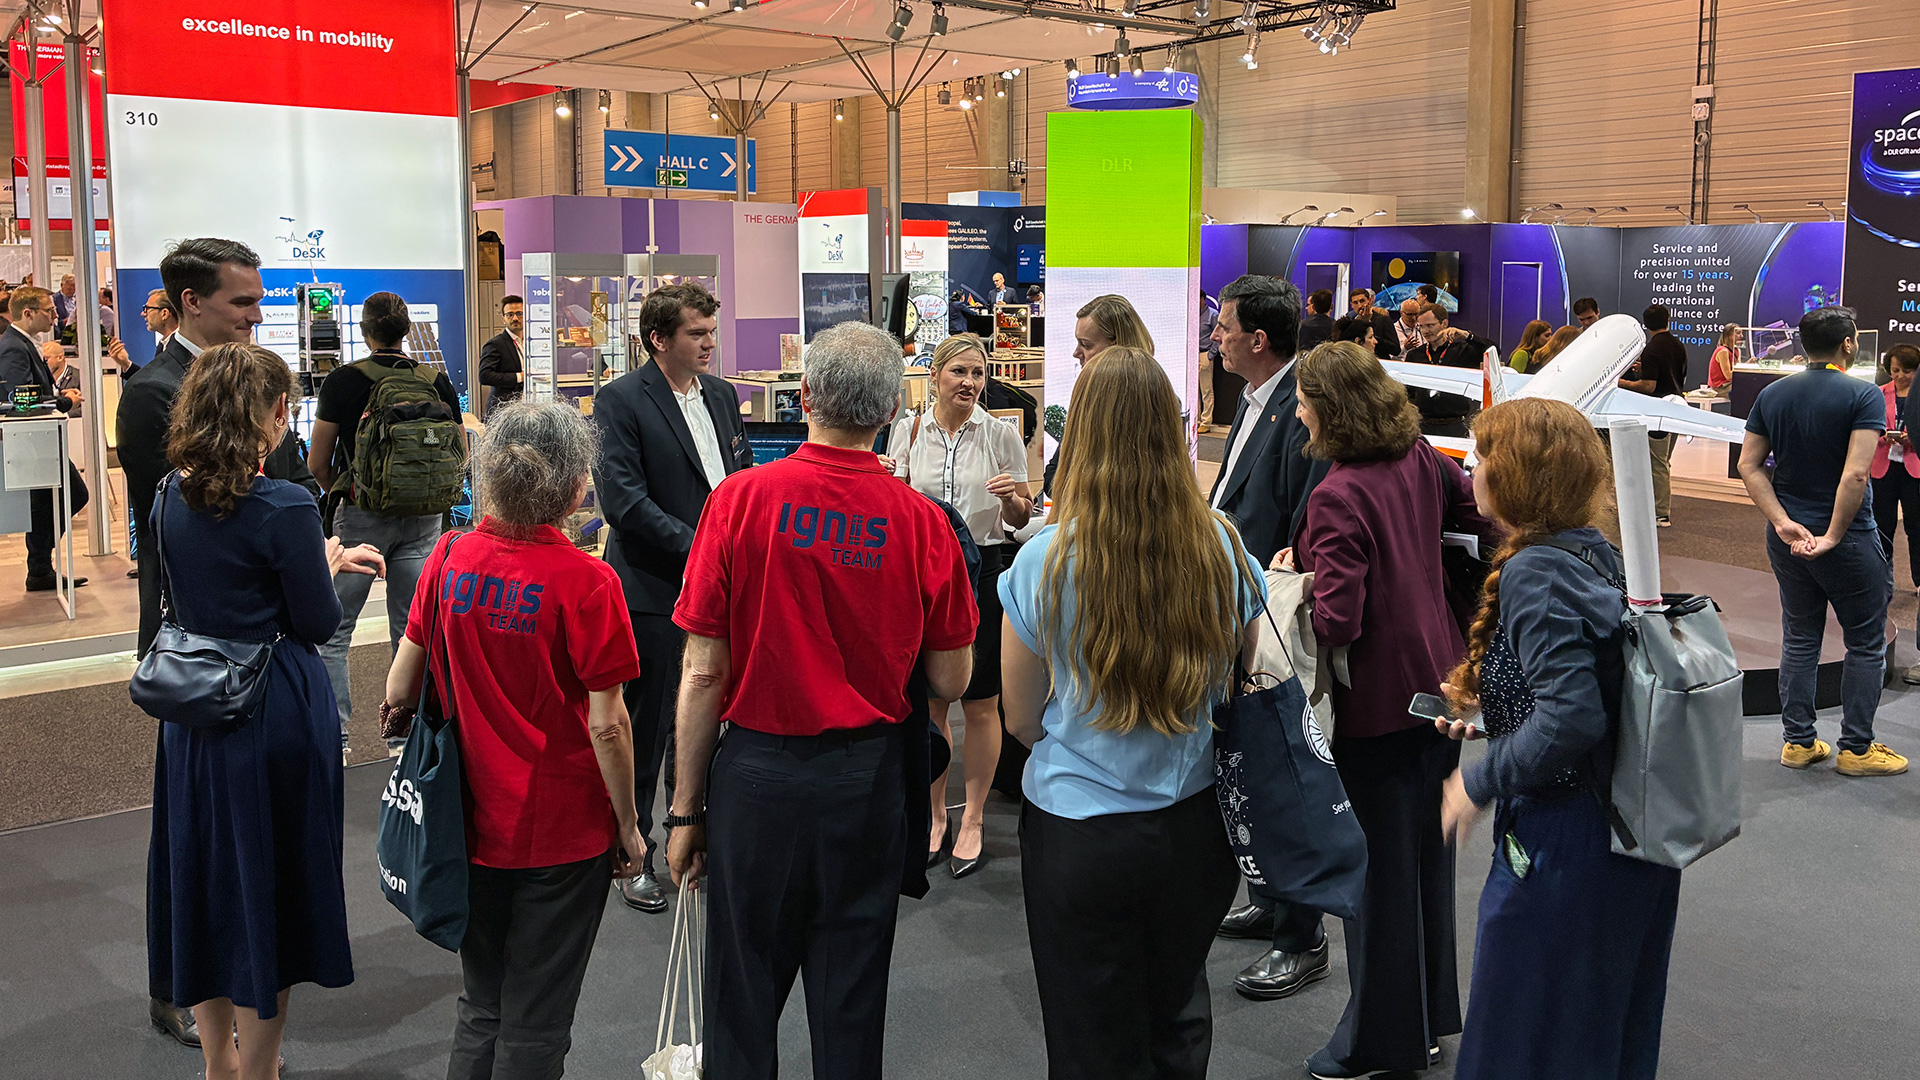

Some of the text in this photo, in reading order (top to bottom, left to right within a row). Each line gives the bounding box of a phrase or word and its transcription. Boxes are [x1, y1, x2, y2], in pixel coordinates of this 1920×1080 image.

[182, 17, 394, 53] excellence in mobility
[125, 111, 159, 127] 310
[1874, 127, 1920, 147] spac
[659, 155, 709, 170] HALL C
[1101, 159, 1133, 172] DLR
[744, 214, 798, 225] THE GERMA
[293, 247, 326, 258] DeSK
[1653, 242, 1718, 254] Service and
[828, 250, 844, 261] DeSK
[1640, 255, 1730, 268] precision united
[1633, 269, 1734, 281] for over 15 years,
[1652, 282, 1715, 294] leading the
[1651, 295, 1715, 305] operational
[1670, 308, 1720, 319] llence of
[1669, 321, 1724, 334] ileo syste
[1888, 318, 1920, 333] Prec
[1673, 334, 1712, 346] urope
[831, 547, 883, 570] TEAM
[487, 612, 537, 635] TEAM
[1332, 801, 1345, 815] See
[1239, 855, 1261, 876] CE
